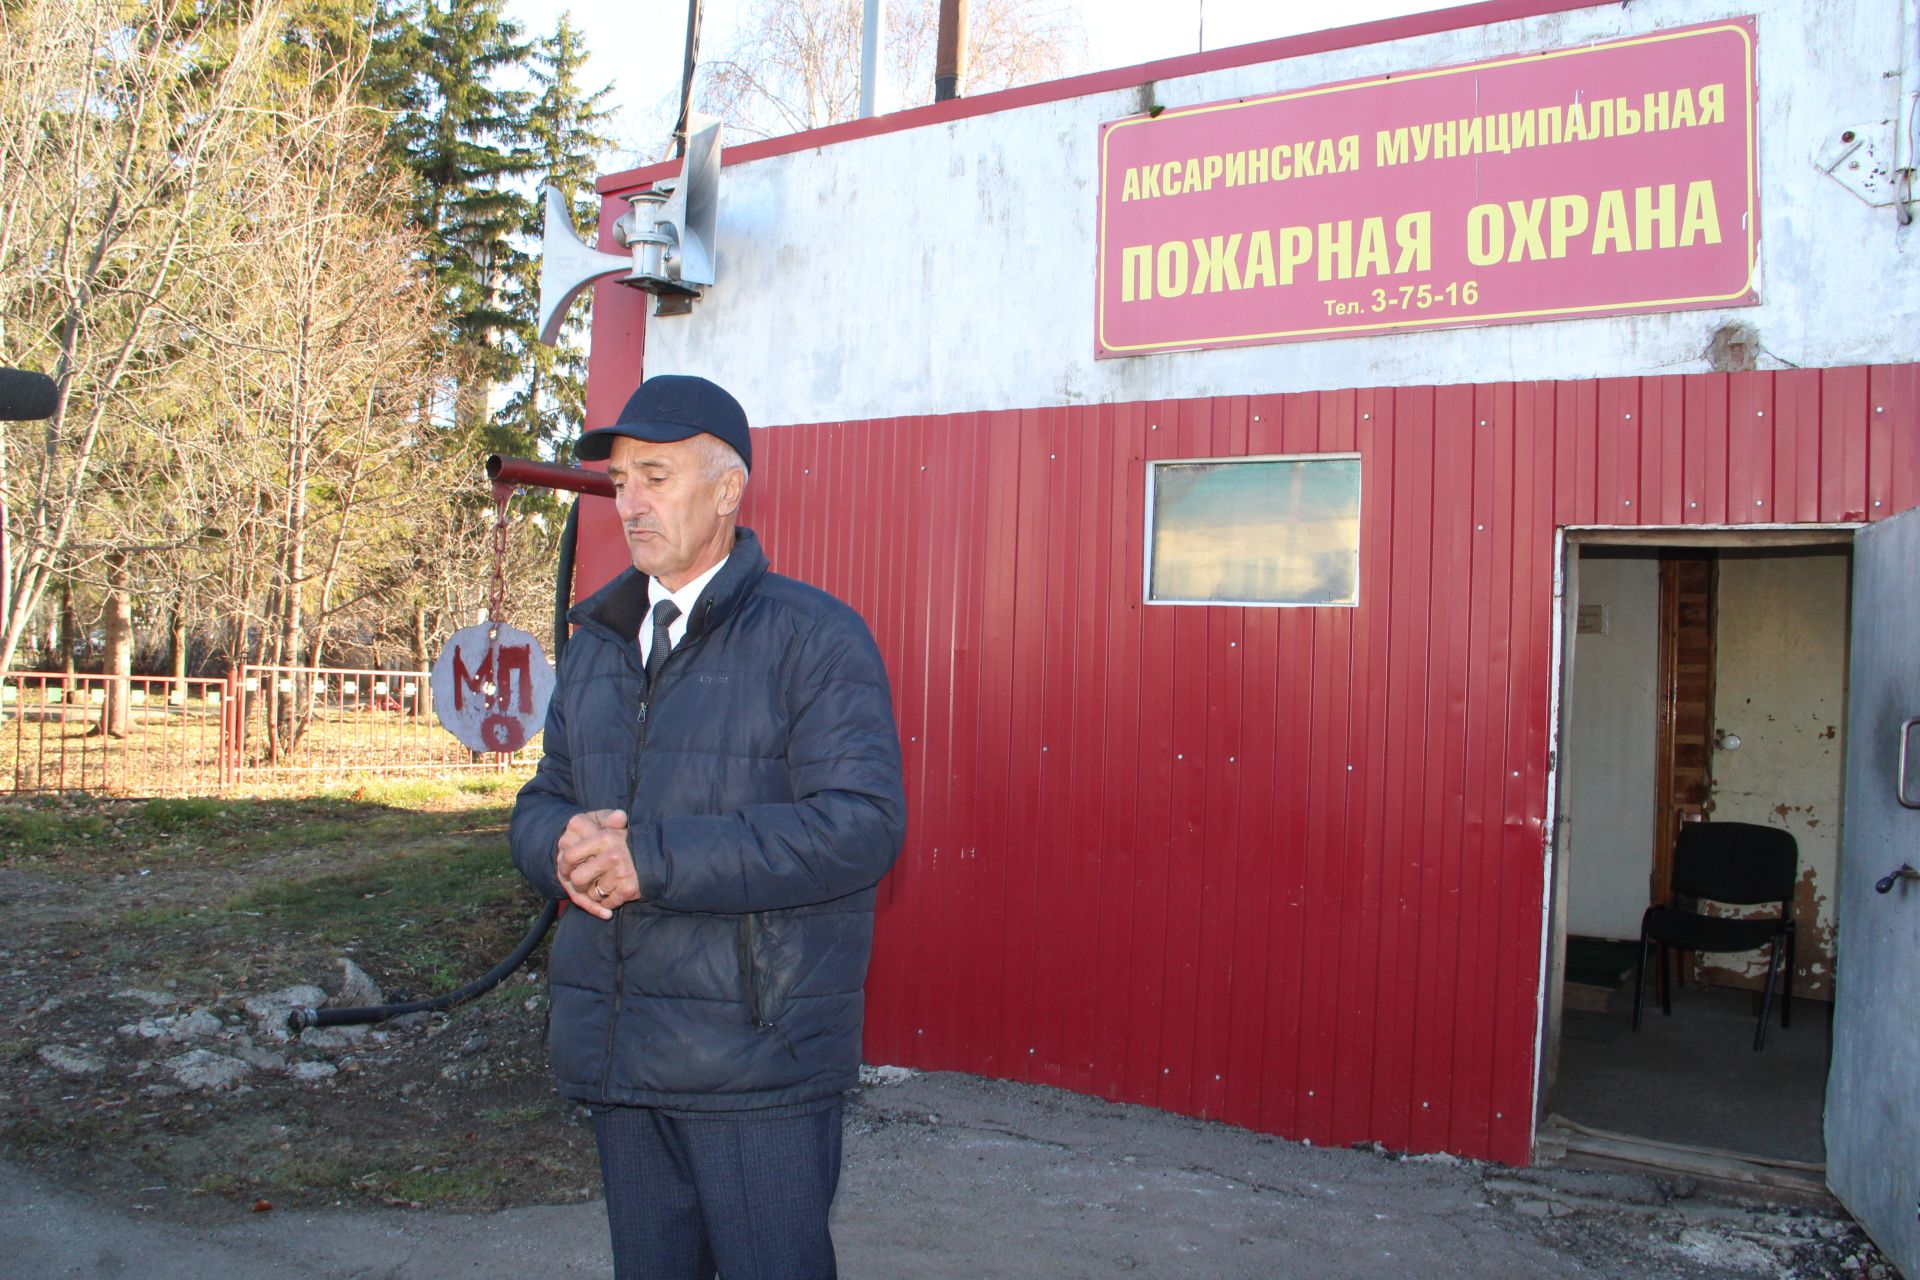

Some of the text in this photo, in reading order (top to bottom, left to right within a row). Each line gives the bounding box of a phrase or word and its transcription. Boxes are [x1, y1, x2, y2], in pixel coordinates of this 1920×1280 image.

[1121, 83, 1725, 203] АКСАРИНСКАЯ МУНИЦИПАЛЬНАЯ
[1121, 180, 1724, 303] ПОЖАРНАЯ ОХРАНА
[1323, 279, 1480, 317] Тел. 3-75-16
